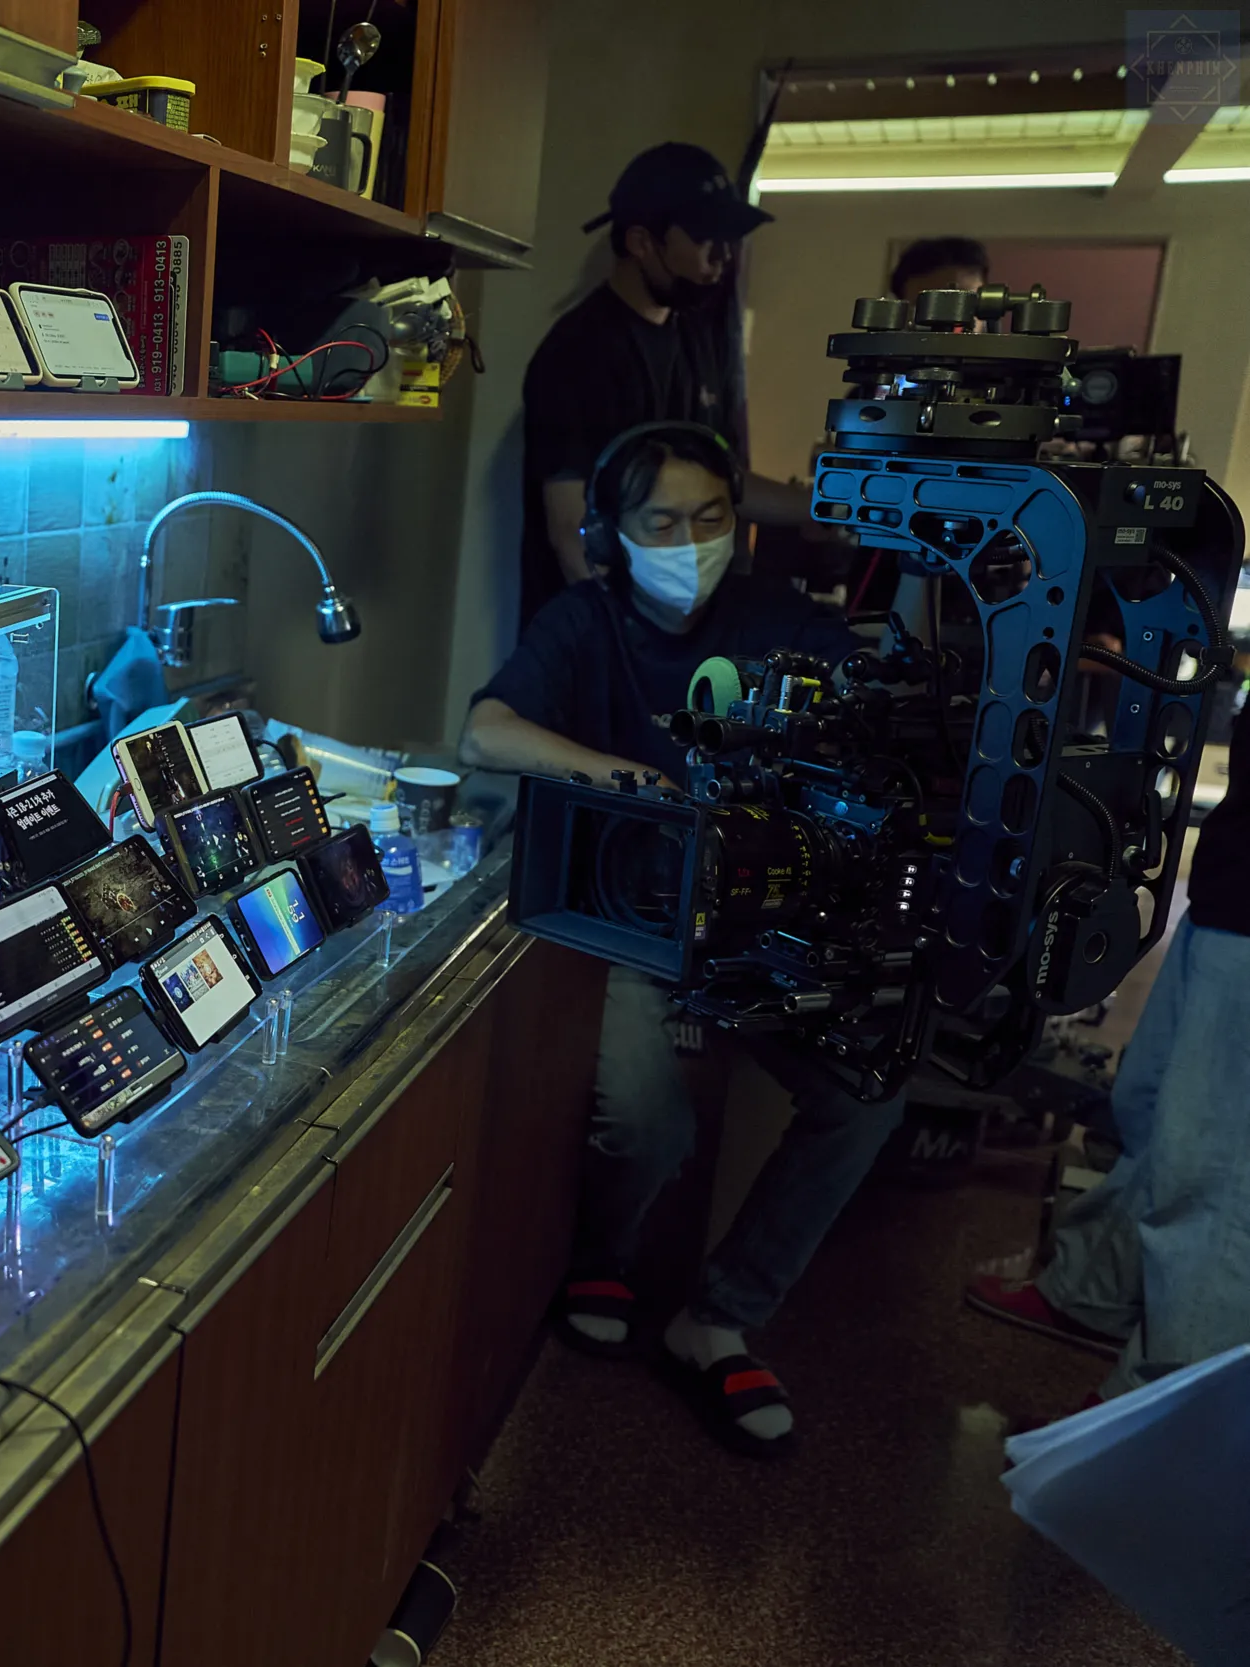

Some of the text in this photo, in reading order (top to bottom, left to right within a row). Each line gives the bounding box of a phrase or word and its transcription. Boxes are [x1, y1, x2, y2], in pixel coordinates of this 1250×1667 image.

[153, 240, 168, 302] 913-0413
[151, 312, 165, 375] 919-0413
[1143, 494, 1184, 511] L 40
[1153, 480, 1182, 491] mo-sys
[16, 811, 44, 831] 업데이트
[1035, 910, 1059, 985] mo-sys
